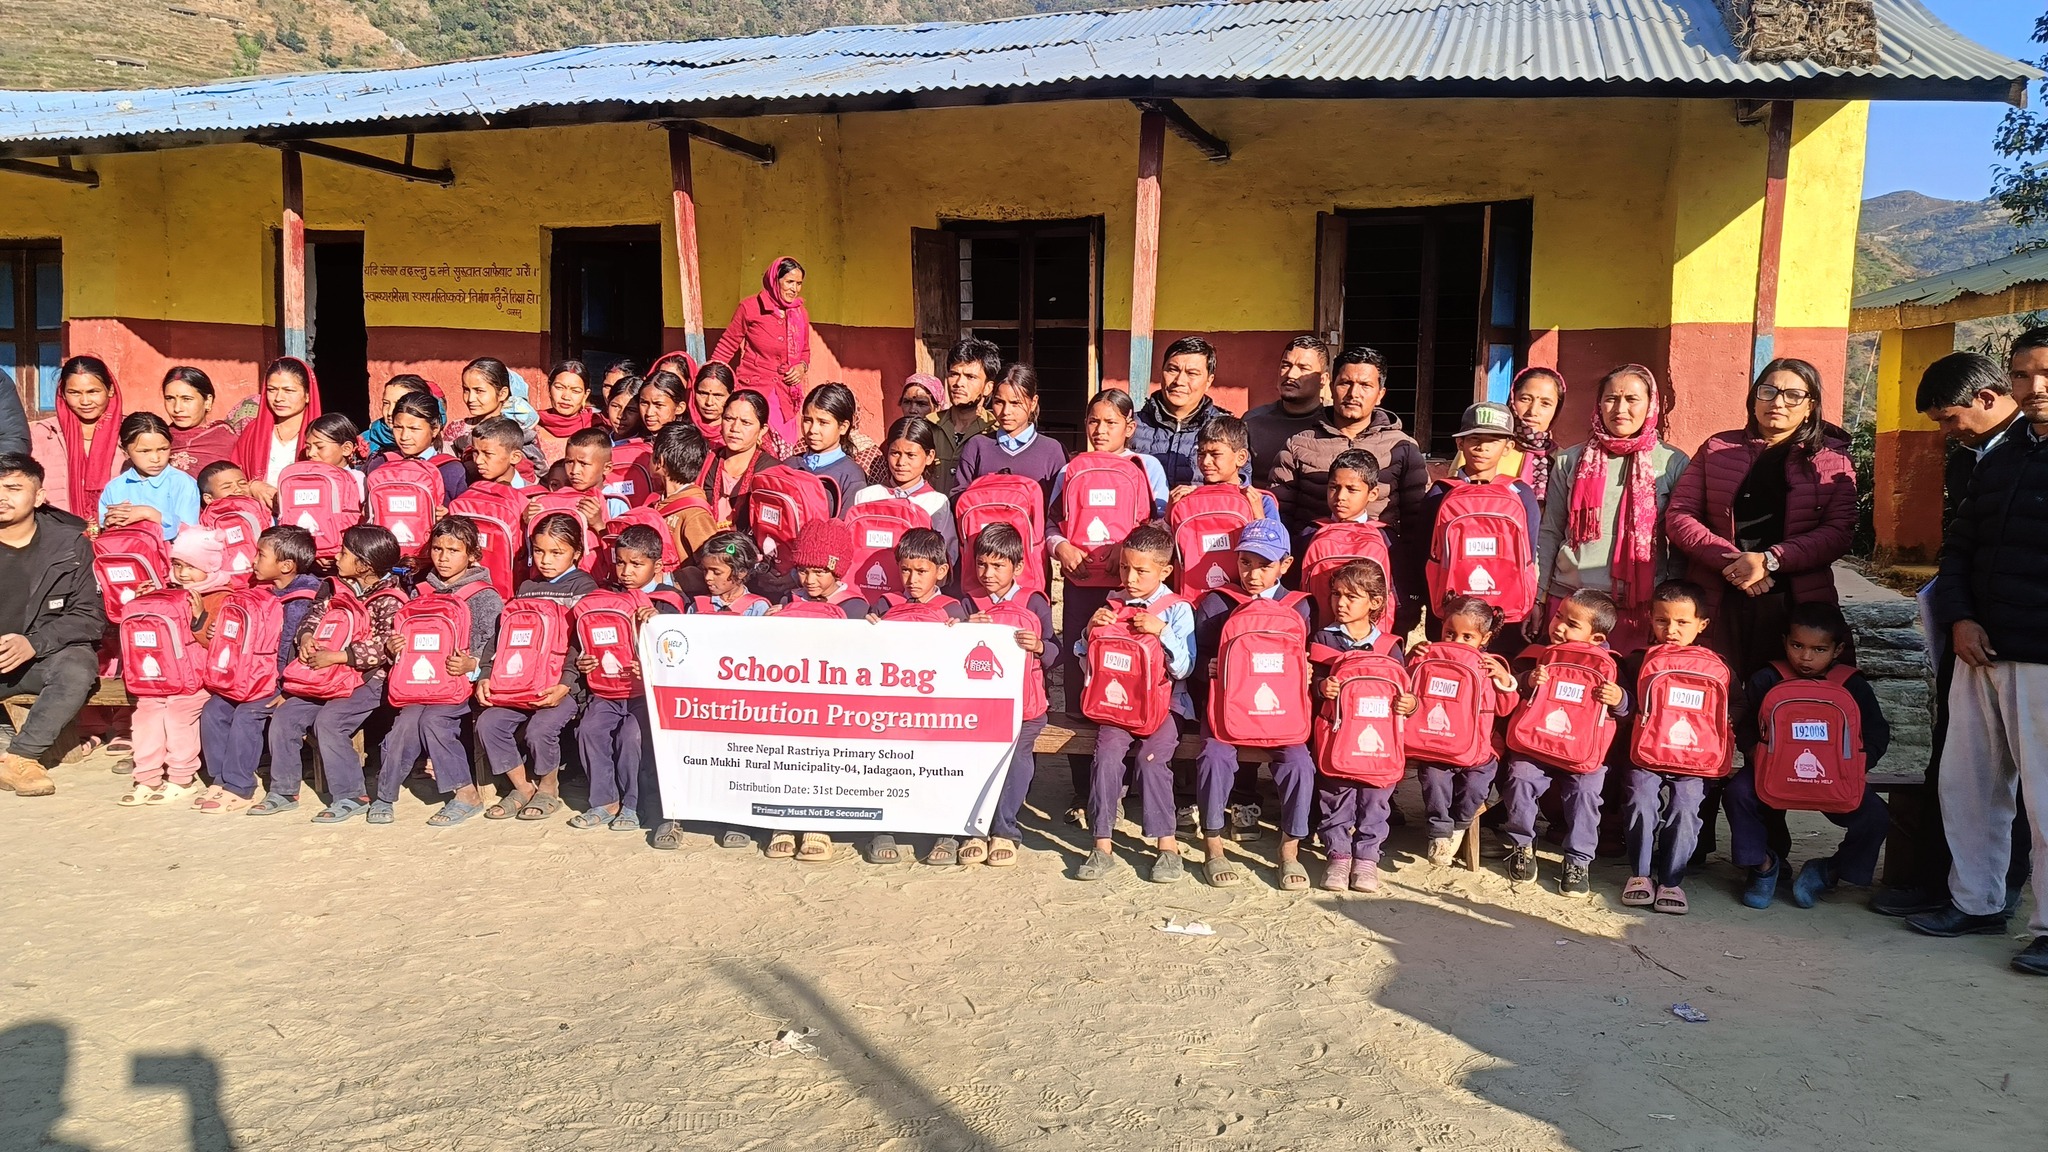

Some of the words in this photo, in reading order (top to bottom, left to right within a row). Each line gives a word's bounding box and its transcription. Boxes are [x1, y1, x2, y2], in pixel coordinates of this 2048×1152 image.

[1468, 542, 1494, 552] 192044
[1106, 654, 1130, 669] 192018
[717, 656, 810, 684] School
[818, 660, 847, 685] In
[856, 667, 872, 687] a
[880, 662, 937, 694] Bag
[1431, 680, 1456, 694] 192007
[1672, 692, 1700, 706] 192010
[674, 697, 819, 726] Distribution
[827, 704, 978, 734] Programme
[1794, 725, 1826, 738] 192008
[726, 742, 754, 753] Shree
[756, 744, 784, 756] Nepal
[787, 746, 830, 758] Rastriya
[833, 748, 876, 760] Primary
[878, 750, 914, 760] School
[683, 756, 708, 766] Gaun
[710, 757, 740, 768] Mukhi
[745, 759, 771, 770] Rural
[773, 761, 860, 774] Municipality-04,
[863, 764, 916, 778] Jadagaon,
[918, 766, 964, 778] Pyuthan
[728, 780, 781, 794] Distribution
[784, 784, 810, 794] Date:
[812, 785, 833, 796] 31st
[836, 786, 884, 798] December
[886, 788, 910, 798] 2025
[786, 808, 807, 816] Must
[808, 808, 823, 816] Not
